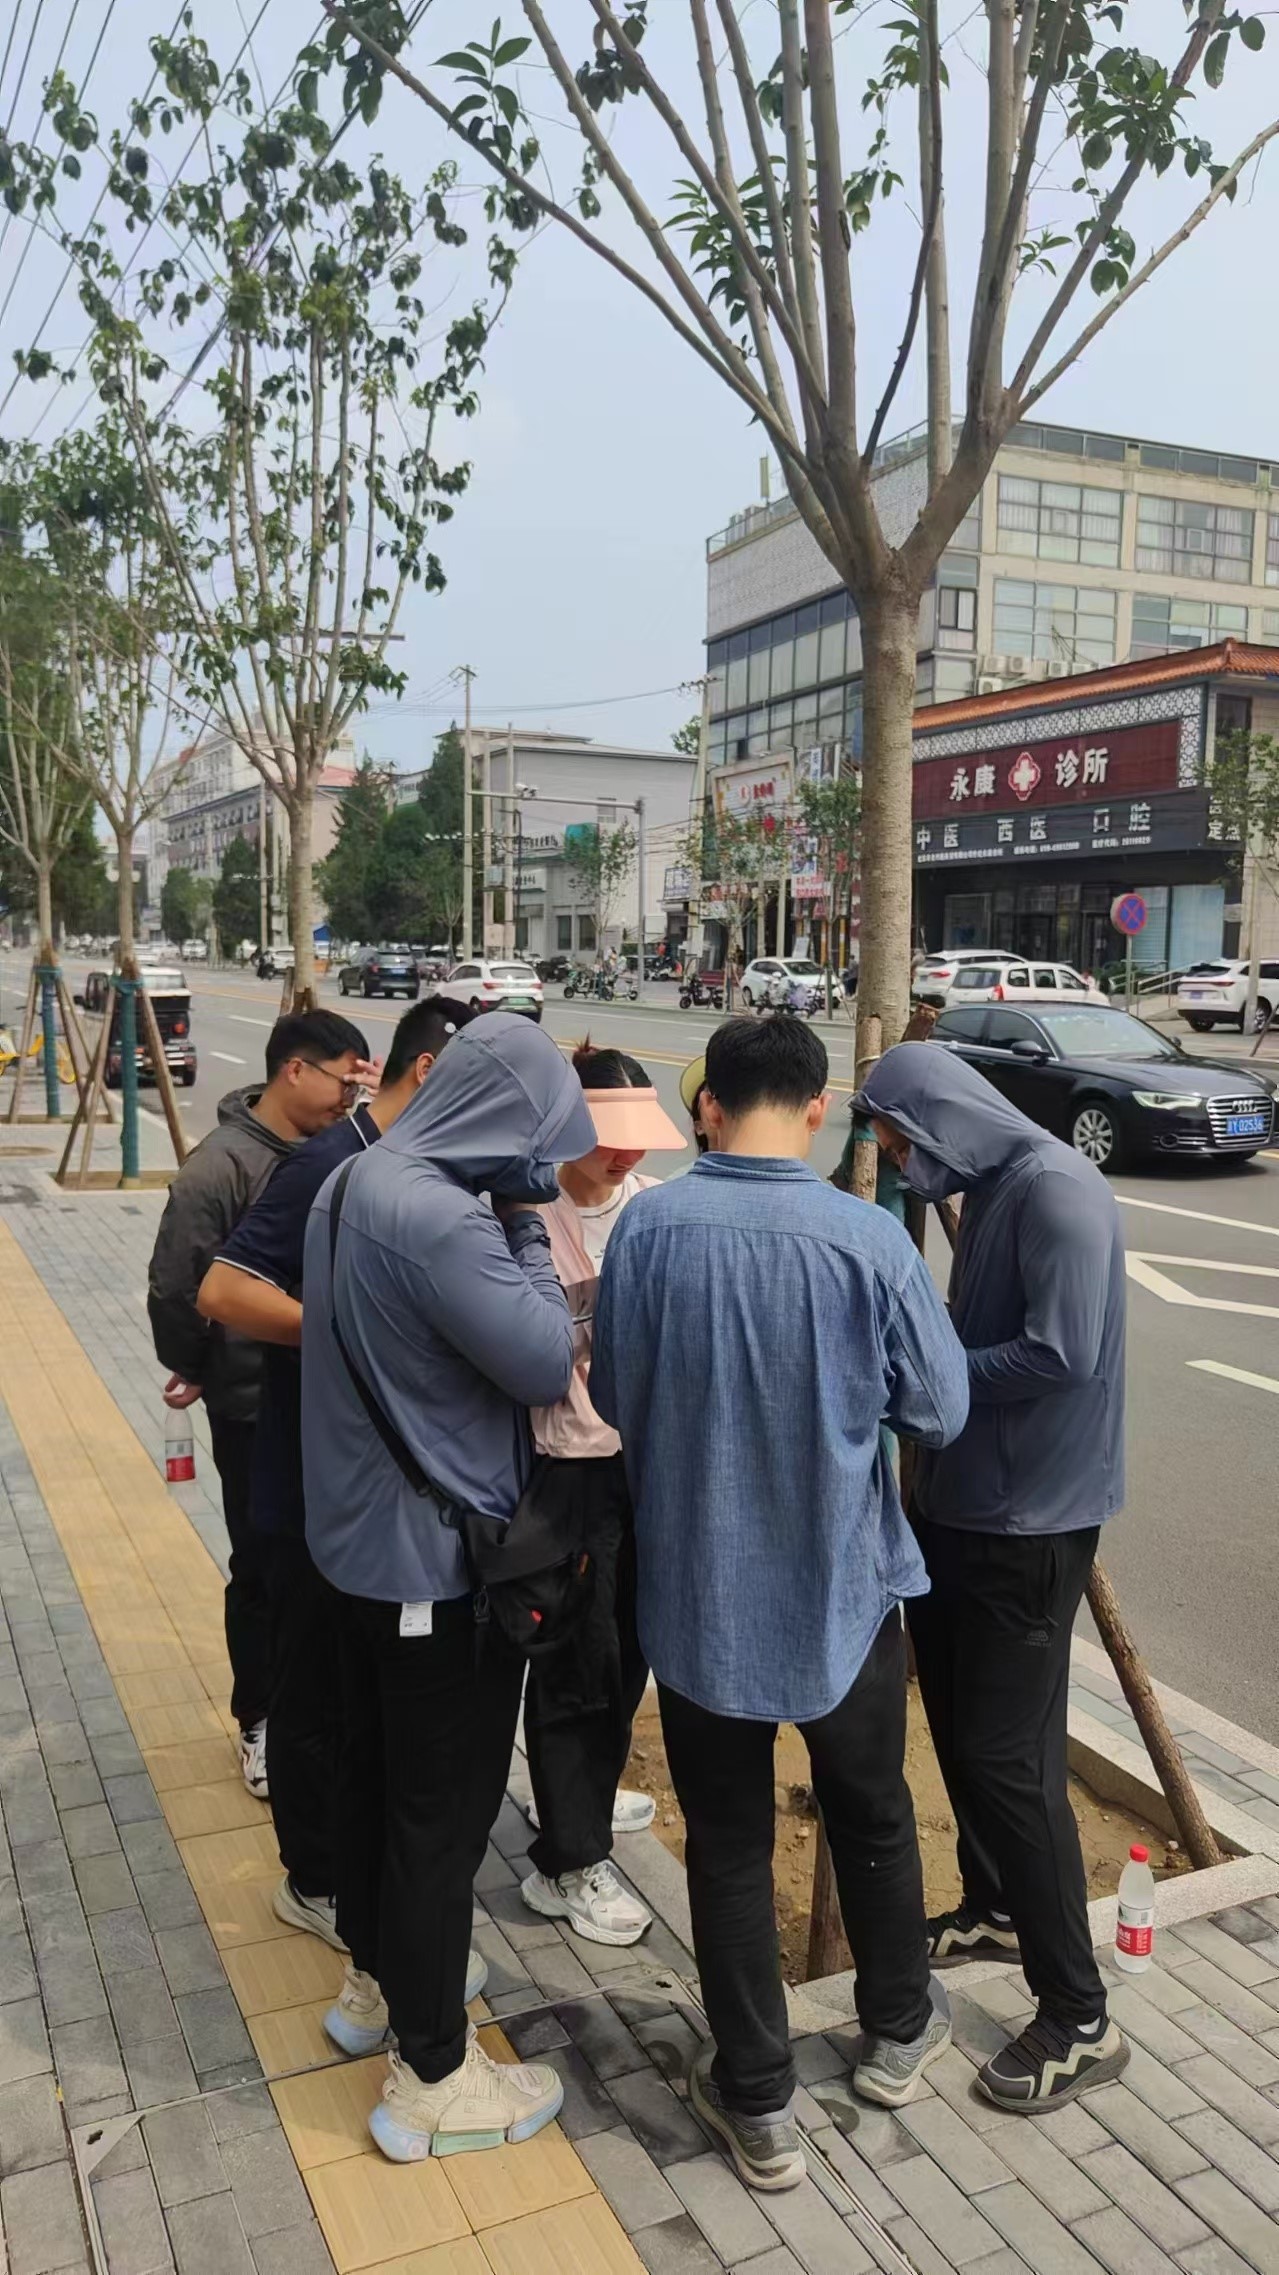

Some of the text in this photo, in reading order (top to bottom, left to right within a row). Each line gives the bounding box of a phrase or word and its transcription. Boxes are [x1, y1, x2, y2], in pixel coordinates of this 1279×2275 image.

[949, 747, 1109, 802] 永康 诊所
[916, 802, 1152, 850] 中医 西医 口腔
